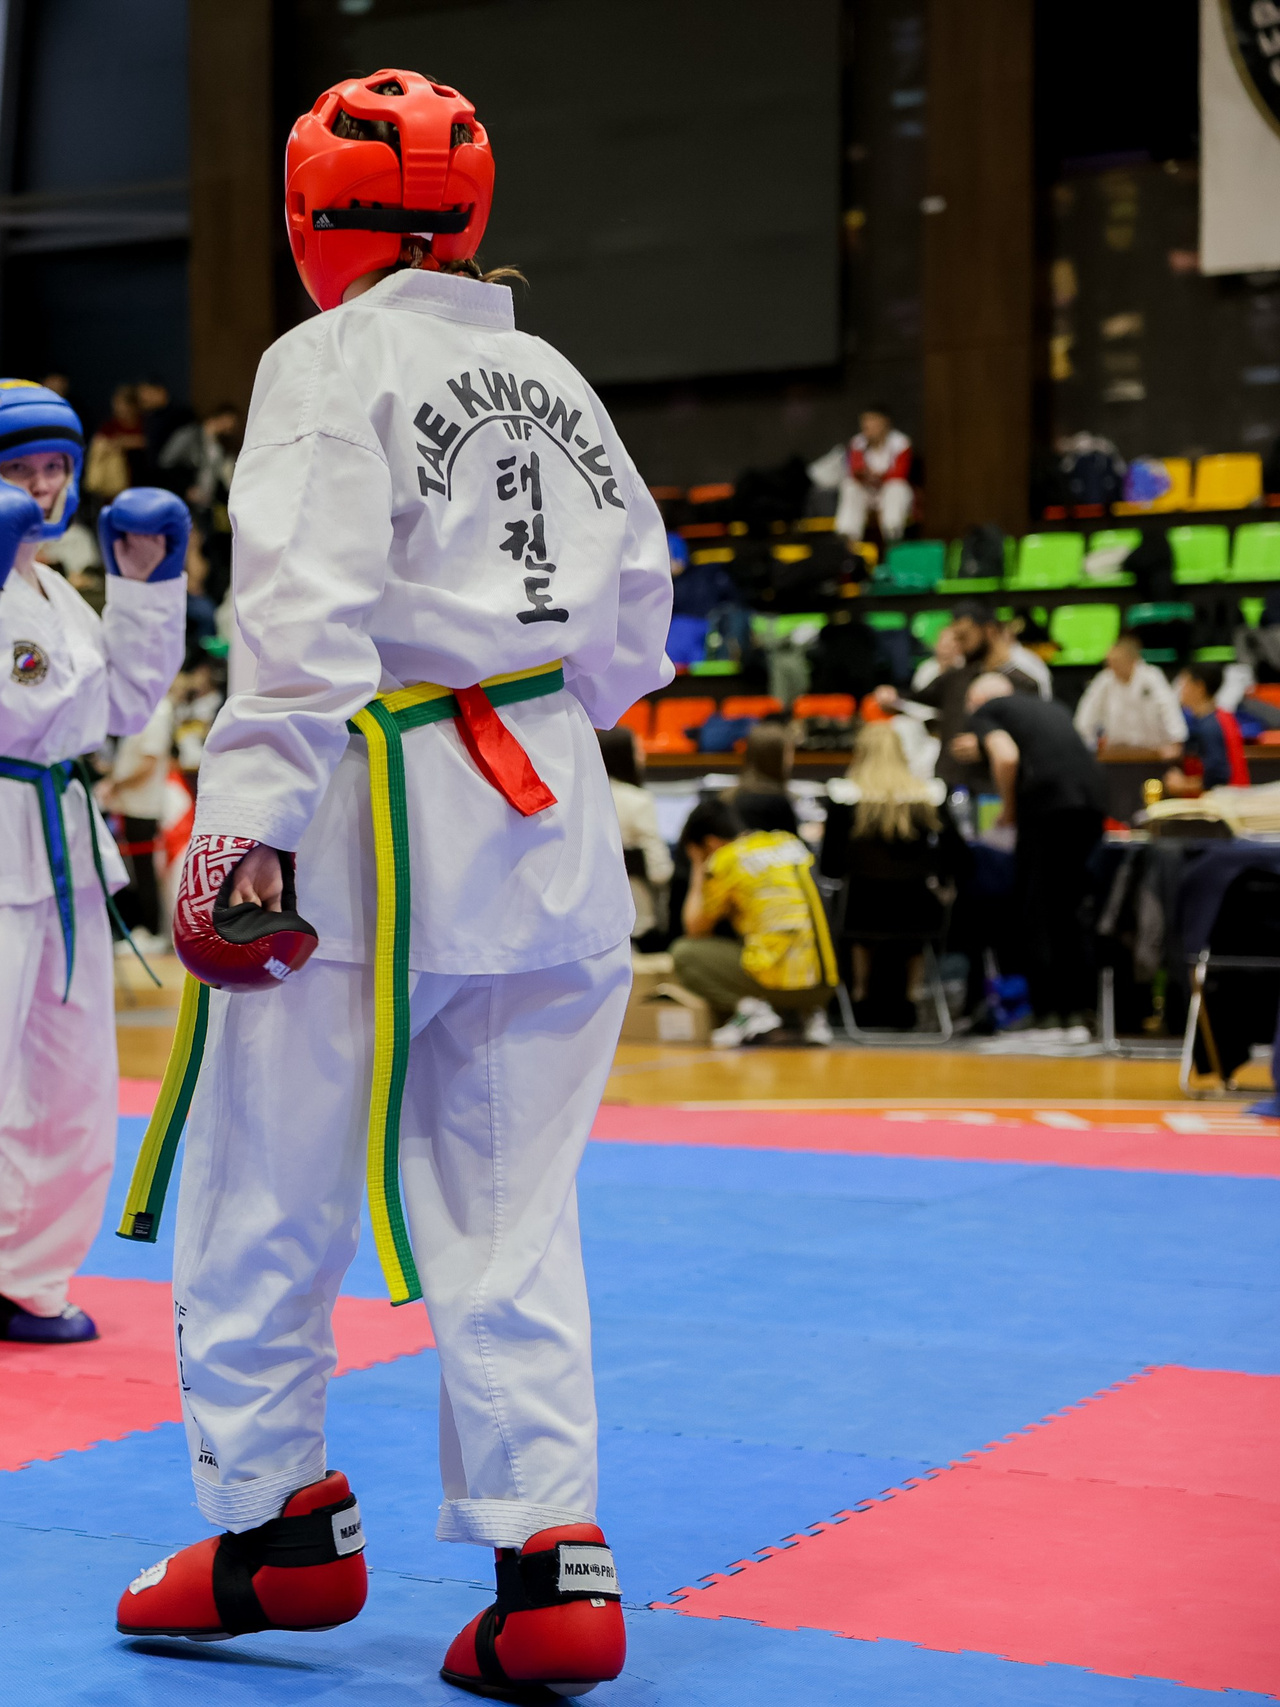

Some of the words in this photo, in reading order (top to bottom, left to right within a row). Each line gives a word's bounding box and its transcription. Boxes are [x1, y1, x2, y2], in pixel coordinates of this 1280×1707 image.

[413, 402, 462, 497] TAE
[502, 417, 533, 441] ITF
[495, 451, 570, 625] 태권도
[564, 1563, 590, 1576] MAX
